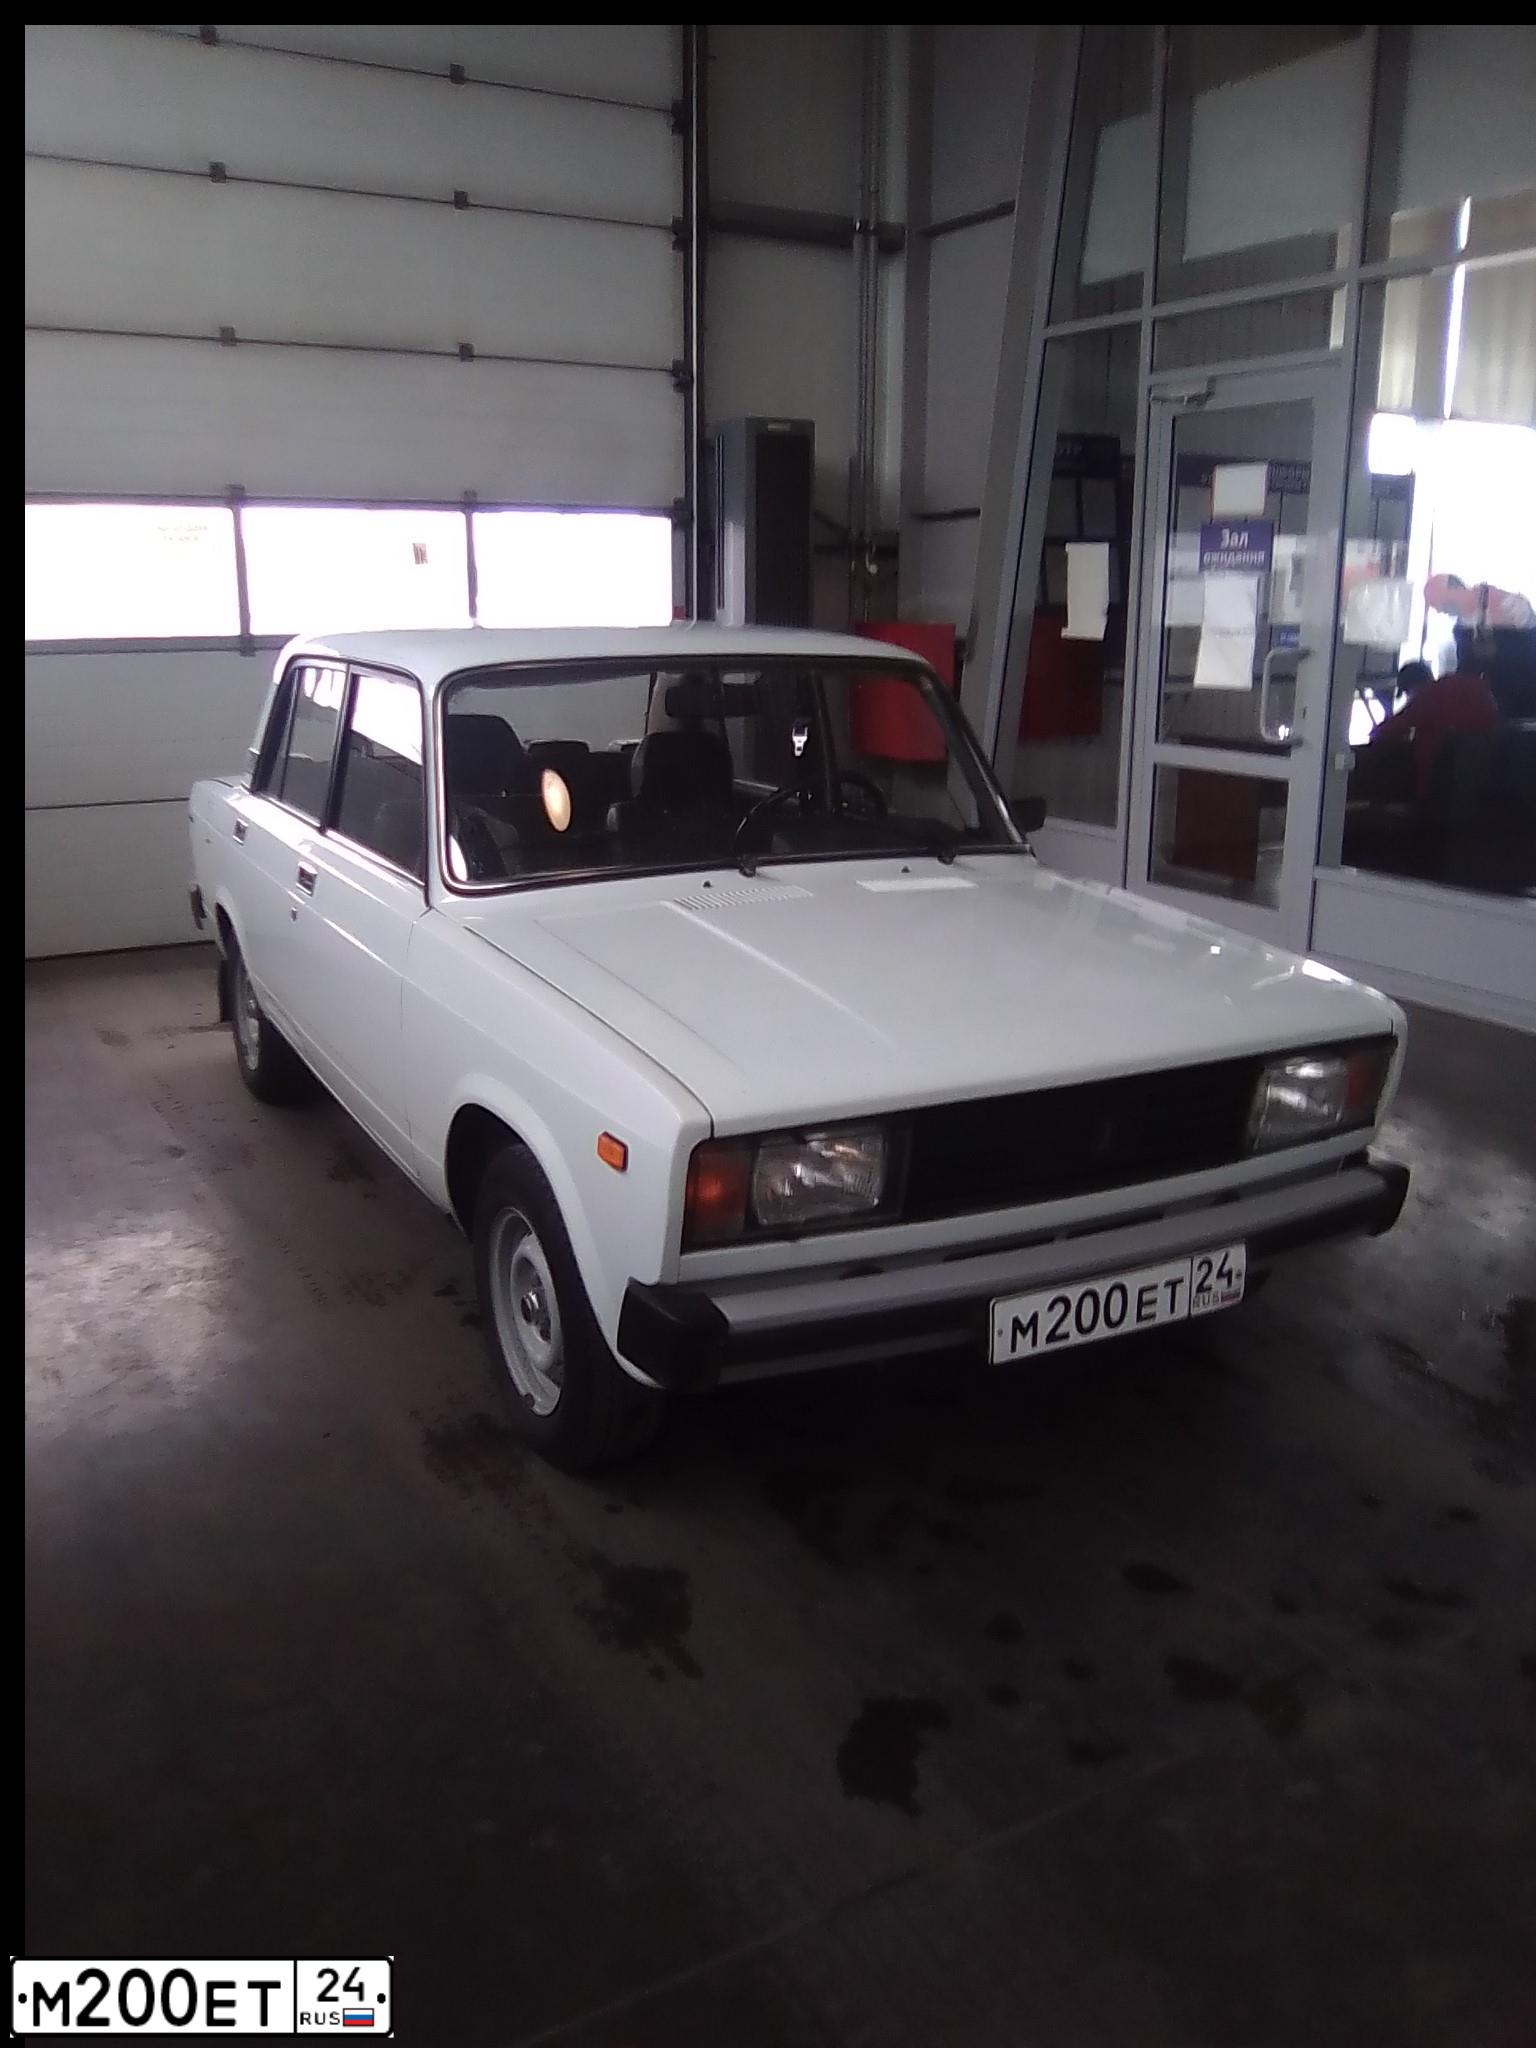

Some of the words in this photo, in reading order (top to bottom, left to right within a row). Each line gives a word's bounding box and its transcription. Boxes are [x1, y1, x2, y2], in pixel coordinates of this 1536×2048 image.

[1221, 528, 1249, 549] Зал
[1203, 551, 1265, 567] ожидания
[1196, 1252, 1232, 1294] 24
